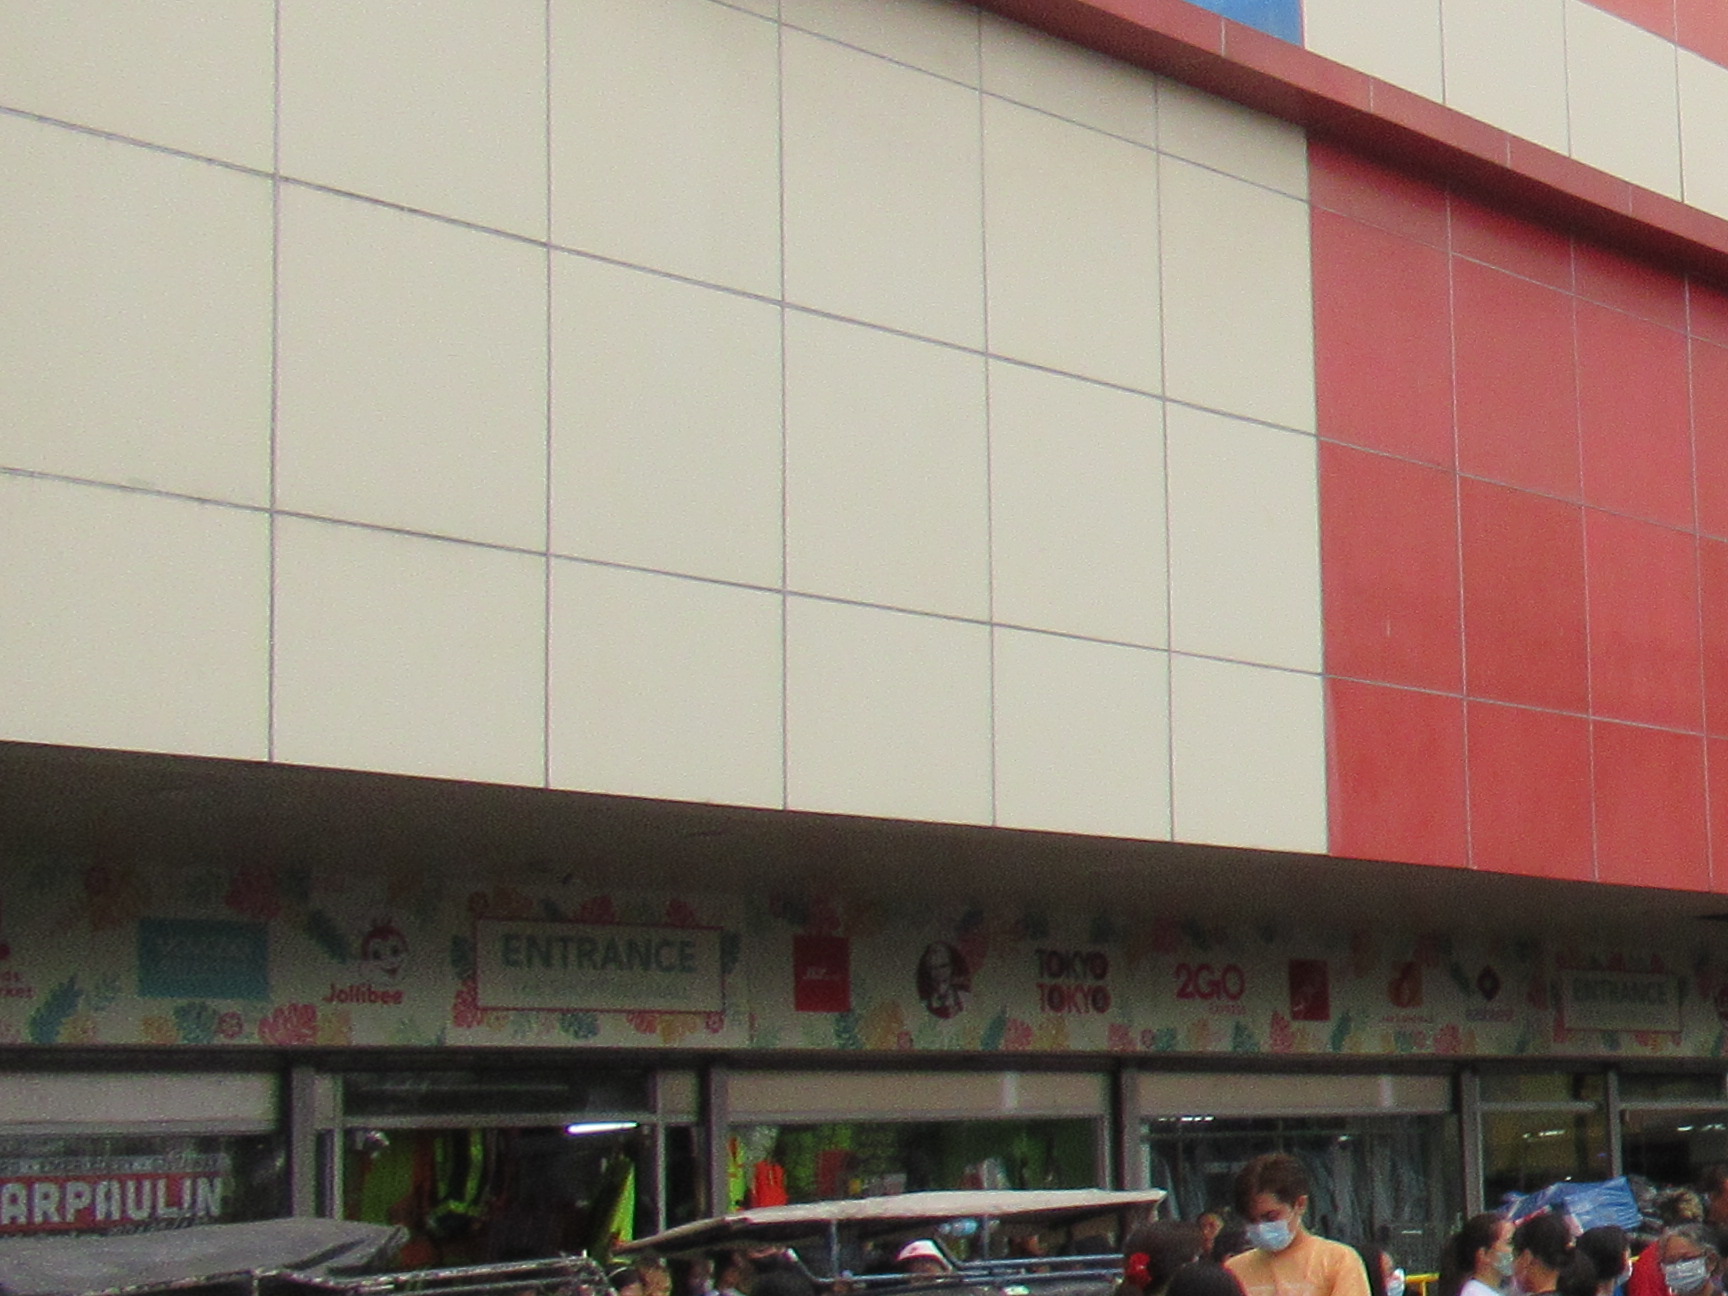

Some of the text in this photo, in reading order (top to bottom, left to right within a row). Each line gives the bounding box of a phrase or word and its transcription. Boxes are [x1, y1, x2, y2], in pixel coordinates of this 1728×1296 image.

[502, 932, 698, 974] ENTRANCE
[1036, 949, 1109, 981] TOKYO
[323, 982, 404, 1005] Jollibee
[1174, 962, 1246, 1001] 2GO
[1572, 976, 1668, 1006] ENTRANCE
[1036, 982, 1112, 1015] TOKYO
